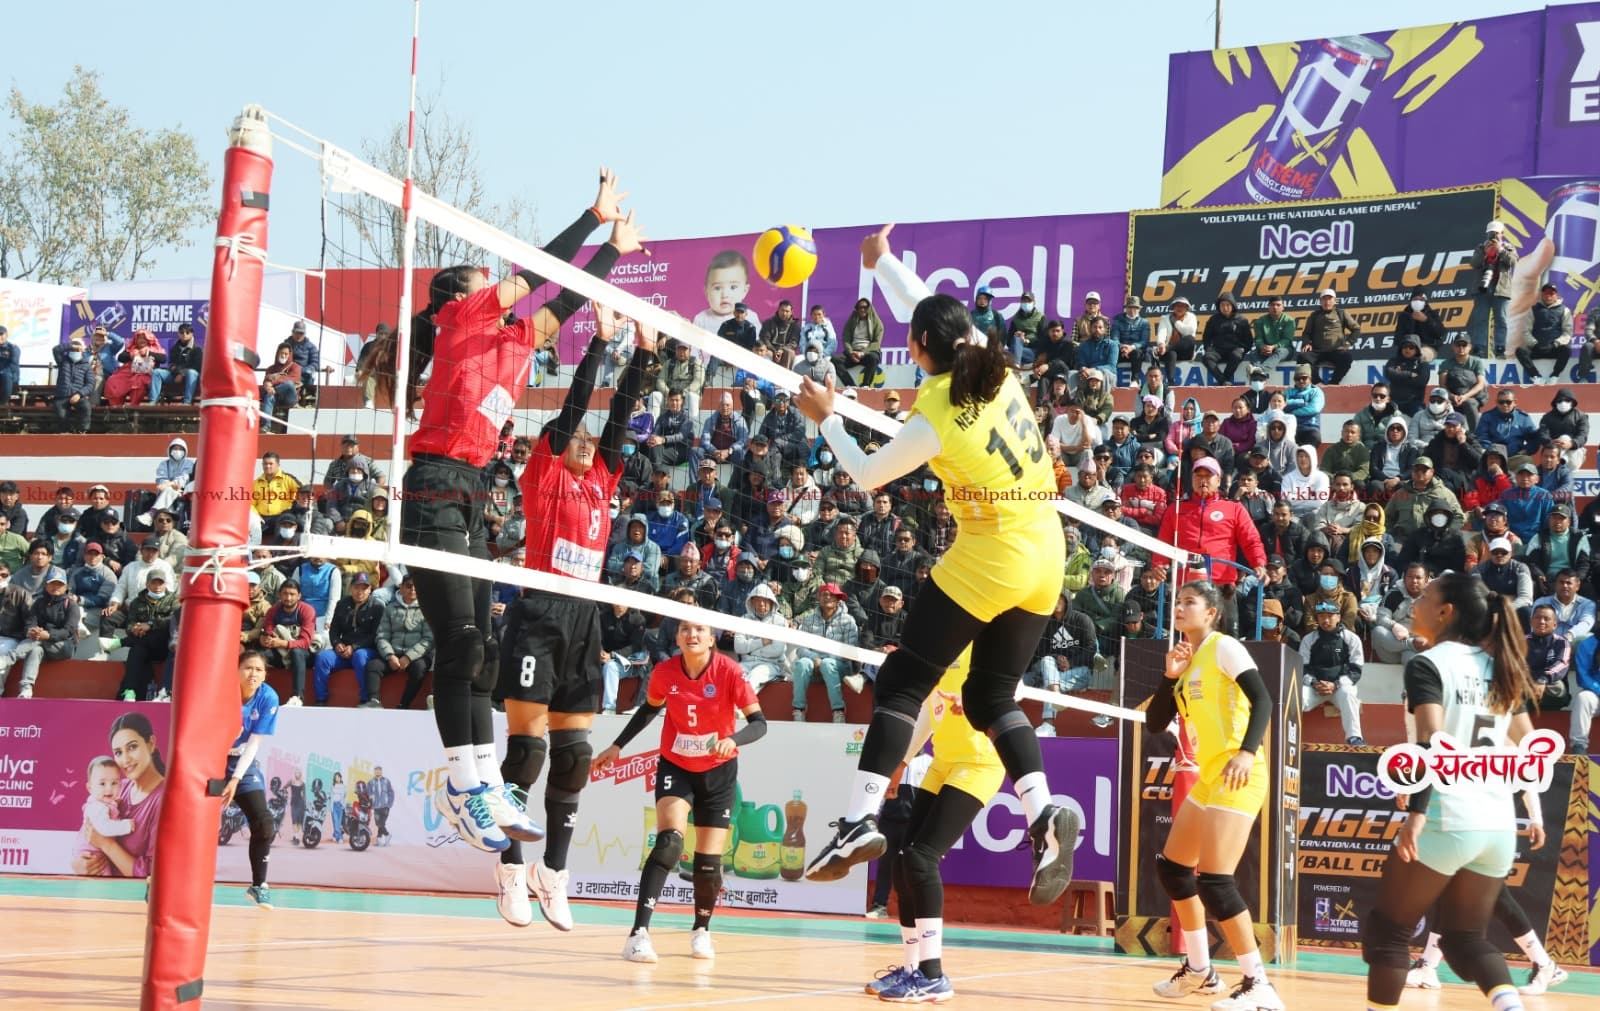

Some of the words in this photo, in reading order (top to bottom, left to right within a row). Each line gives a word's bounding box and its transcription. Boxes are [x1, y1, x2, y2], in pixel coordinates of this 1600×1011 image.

[1267, 212, 1286, 221] THE
[1288, 208, 1337, 219] NATIONAL
[1339, 206, 1368, 216] GAME
[1370, 204, 1383, 214] OF
[1260, 219, 1355, 260] Ncell
[644, 273, 667, 283] CLINIC
[1142, 268, 1210, 302] 6TH
[1218, 259, 1359, 299] TIGER
[132, 304, 192, 322] XTREME
[985, 396, 1044, 481] 15
[588, 510, 601, 541] 8
[519, 655, 537, 688] 8
[687, 704, 698, 728] 5
[664, 776, 673, 790] 5
[1364, 842, 1391, 852] CLUB
[1313, 884, 1342, 892] POWERED
[1330, 919, 1359, 928] XTREME
